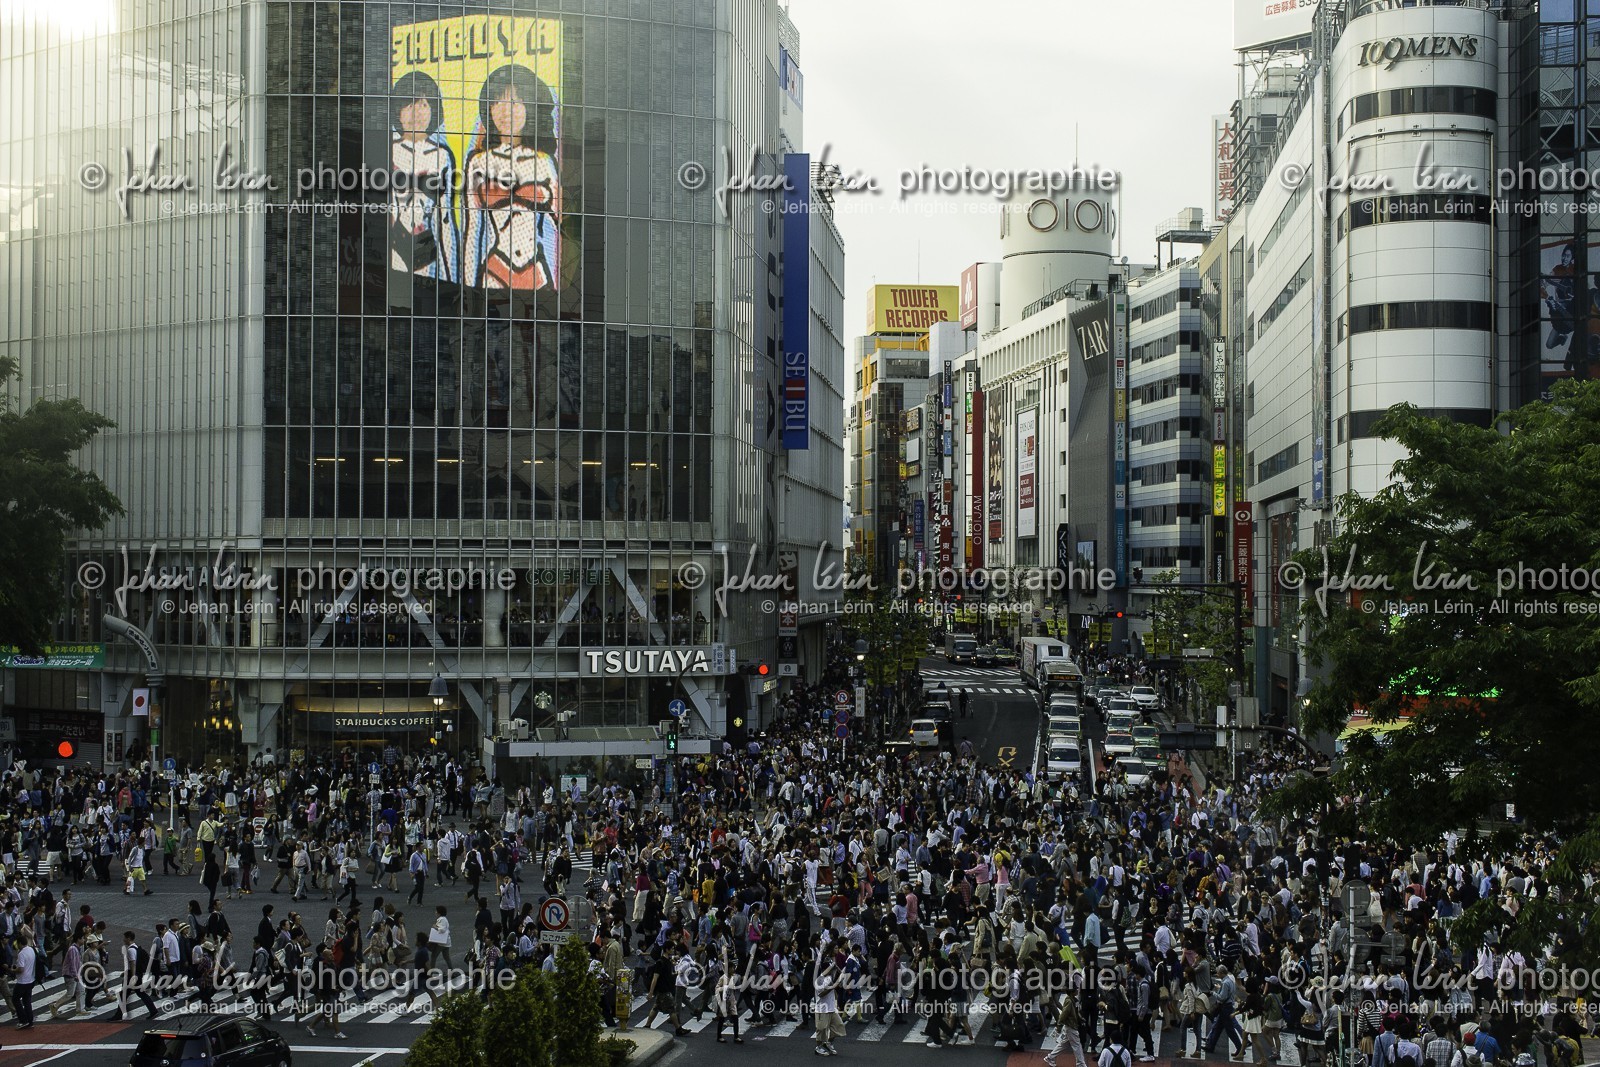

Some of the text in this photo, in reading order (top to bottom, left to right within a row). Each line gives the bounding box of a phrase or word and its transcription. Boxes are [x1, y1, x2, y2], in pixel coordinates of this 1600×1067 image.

[1265, 0, 1296, 16] 広告募集
[392, 19, 555, 66] SHIBUYA
[1218, 122, 1234, 201] 大和証券
[890, 288, 938, 308] TOWER
[886, 309, 948, 328] RECORDS
[786, 352, 806, 432] SEIBU
[926, 395, 936, 457] KARAOKE
[1059, 531, 1067, 568] ZARA
[525, 568, 611, 586] COFFEE
[1238, 538, 1248, 616] 三菱東京UJ
[128, 629, 158, 668] 渋谷センター街
[47, 658, 94, 666] 渋谷センター街
[586, 650, 709, 674] TSUTAYA
[335, 717, 434, 726] STARBUCKS COFFEE
[542, 934, 568, 942] ここから
